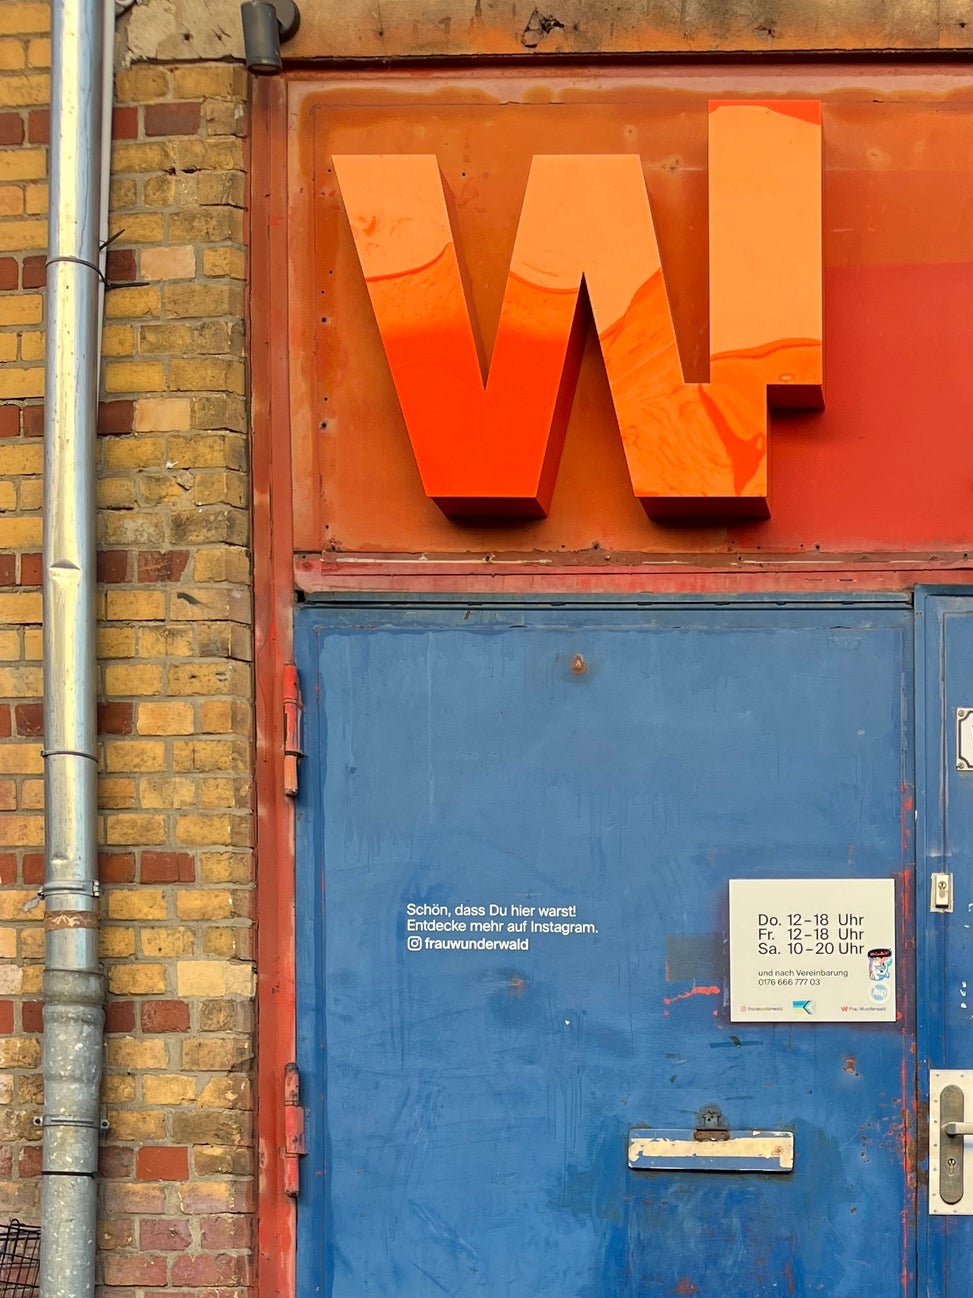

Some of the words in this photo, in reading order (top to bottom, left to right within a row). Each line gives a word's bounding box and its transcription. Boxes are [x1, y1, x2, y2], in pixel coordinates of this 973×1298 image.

[406, 903, 452, 917] Schön,
[455, 904, 486, 917] dass
[489, 904, 508, 917] Du
[511, 904, 536, 917] hier
[538, 905, 577, 918] warst!
[758, 913, 782, 926] Do.
[838, 913, 865, 926] Uhr
[407, 919, 467, 932] Entdecke
[470, 919, 504, 932] mehr
[507, 920, 527, 932] auf
[531, 920, 599, 936] Instagram.
[758, 928, 775, 940] Fr.
[838, 928, 865, 940] Uhr
[425, 938, 530, 950] frauwunderwald
[758, 942, 781, 955] Sa.
[838, 942, 865, 955] Uhr
[796, 970, 849, 978] Vereinbarung
[758, 978, 776, 986] 0176
[777, 978, 794, 986] 666
[795, 978, 808, 986] 777
[809, 978, 821, 986] 03
